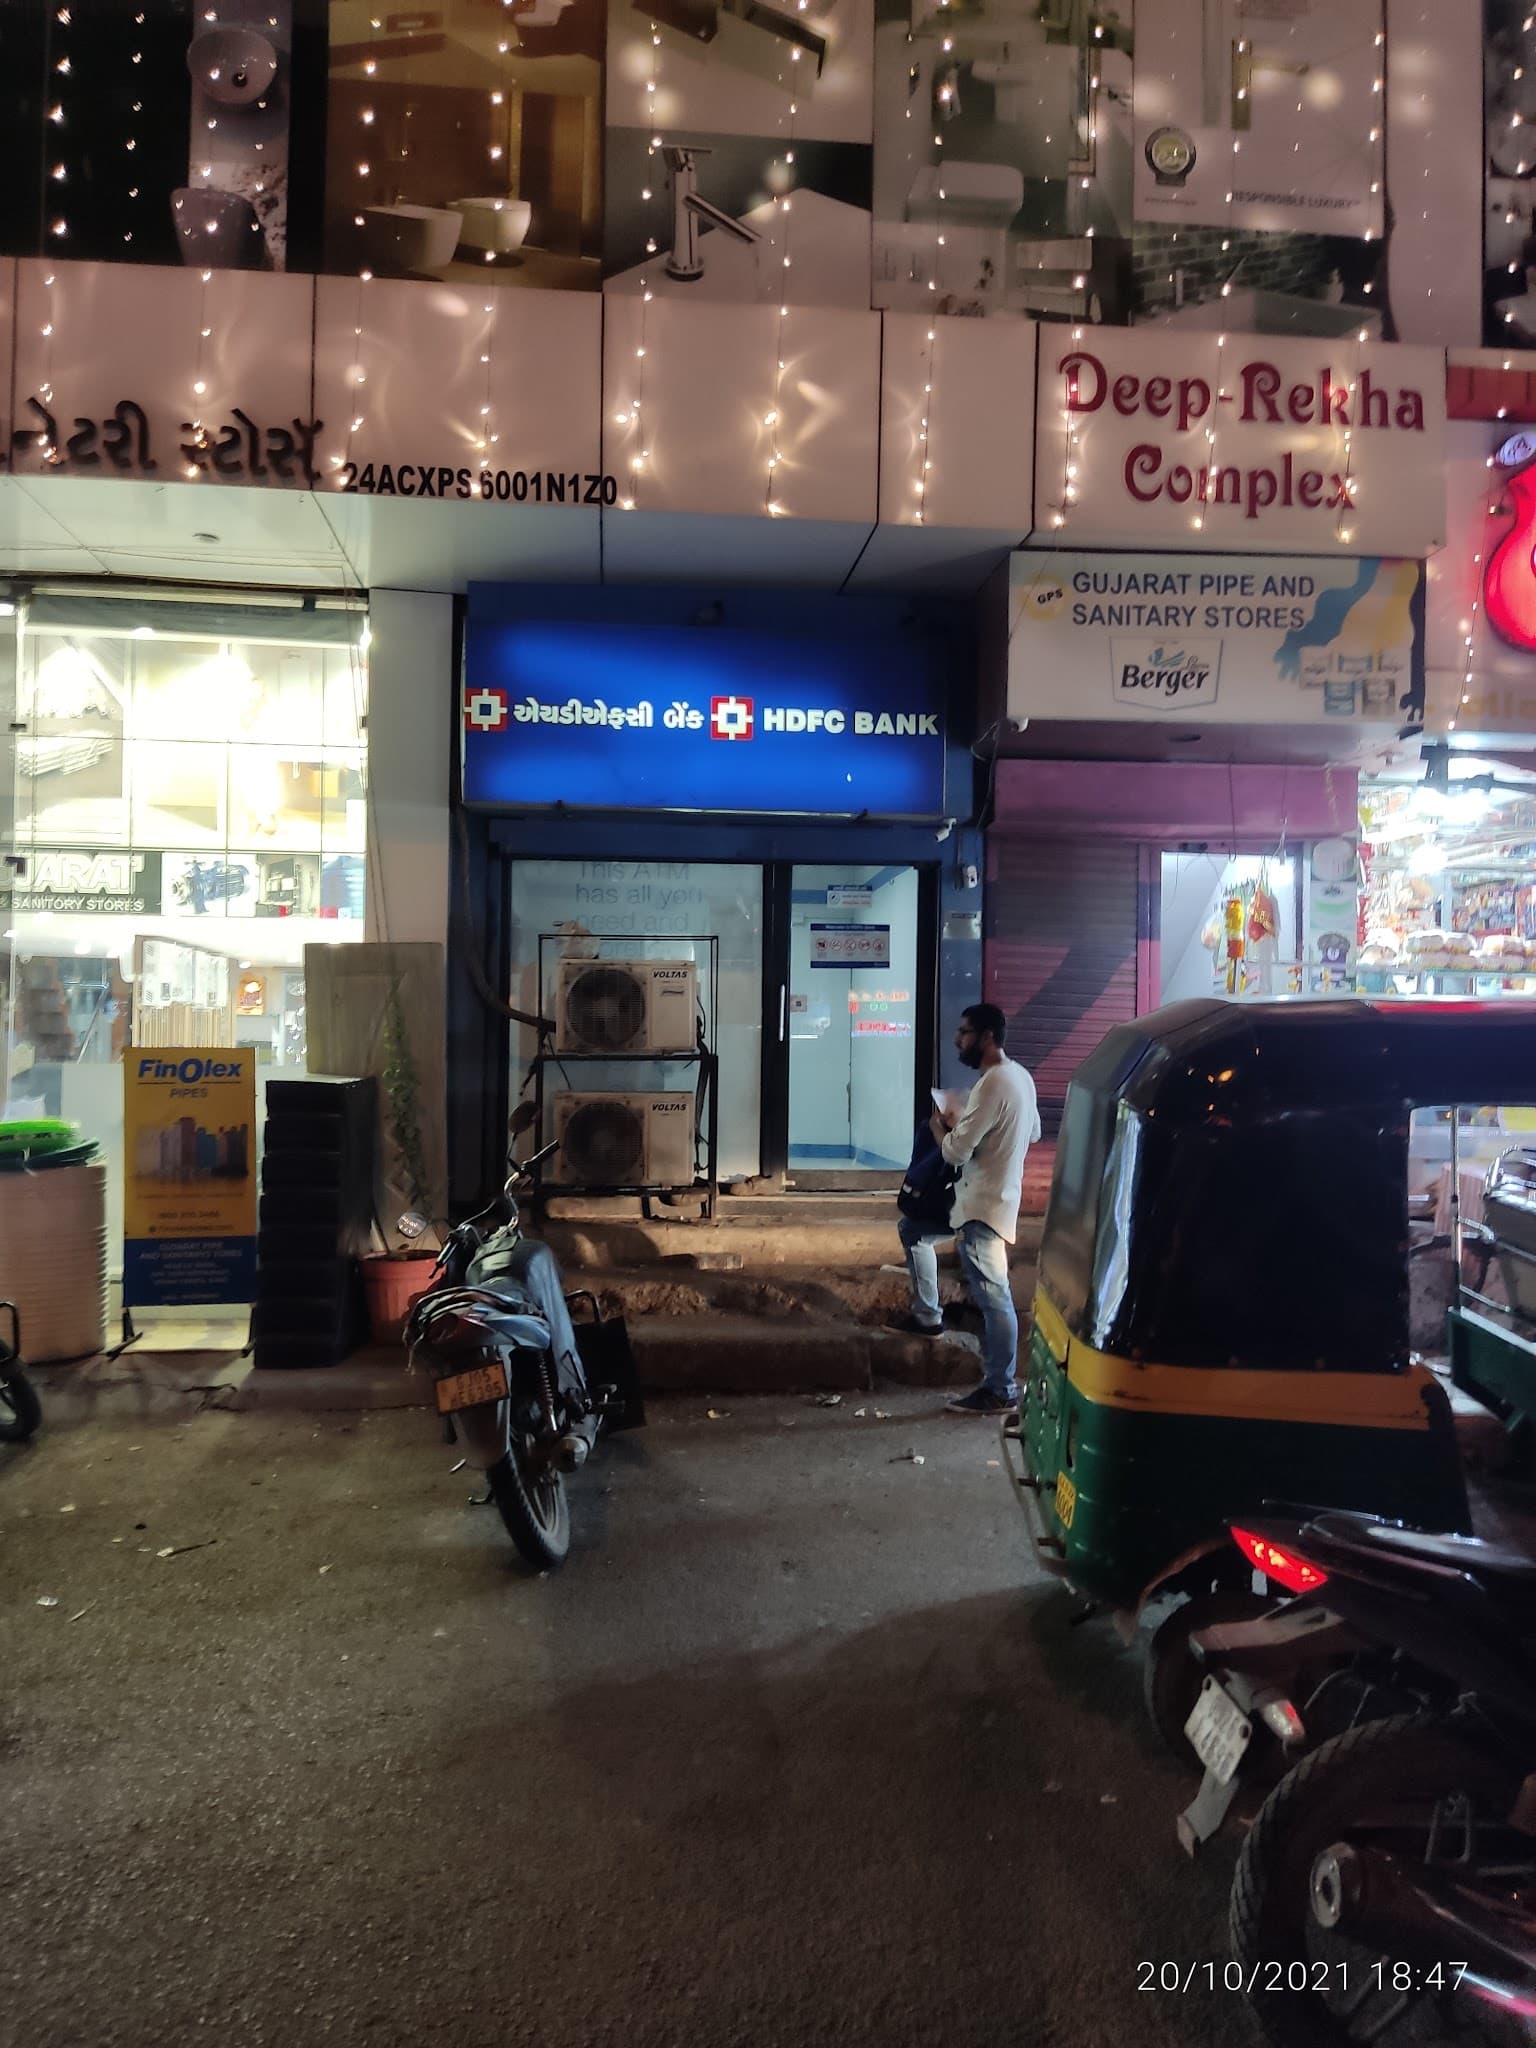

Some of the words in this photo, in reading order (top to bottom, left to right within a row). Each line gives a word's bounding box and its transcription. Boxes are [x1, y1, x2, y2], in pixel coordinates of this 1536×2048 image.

[1057, 351, 1425, 432] Deep-Rekha
[1123, 443, 1354, 519] Complex
[1037, 587, 1063, 605] GPS
[1072, 571, 1192, 596] GUJARAT
[1199, 574, 1255, 597] PIPE
[1261, 576, 1315, 598] AND
[1072, 603, 1197, 627] SANITARY
[1204, 606, 1305, 629] STORES
[1120, 663, 1210, 697] Berger
[513, 696, 654, 731] એચડીએફસી
[763, 707, 846, 734] HDFC
[853, 710, 939, 736] BANK
[12, 896, 86, 910] SANITORY
[86, 897, 145, 912] STORES
[575, 883, 619, 905] has
[626, 884, 651, 905] all
[653, 970, 689, 979] VOLTAS
[169, 1087, 209, 1099] PIPES
[652, 1103, 687, 1112] VOLTAS
